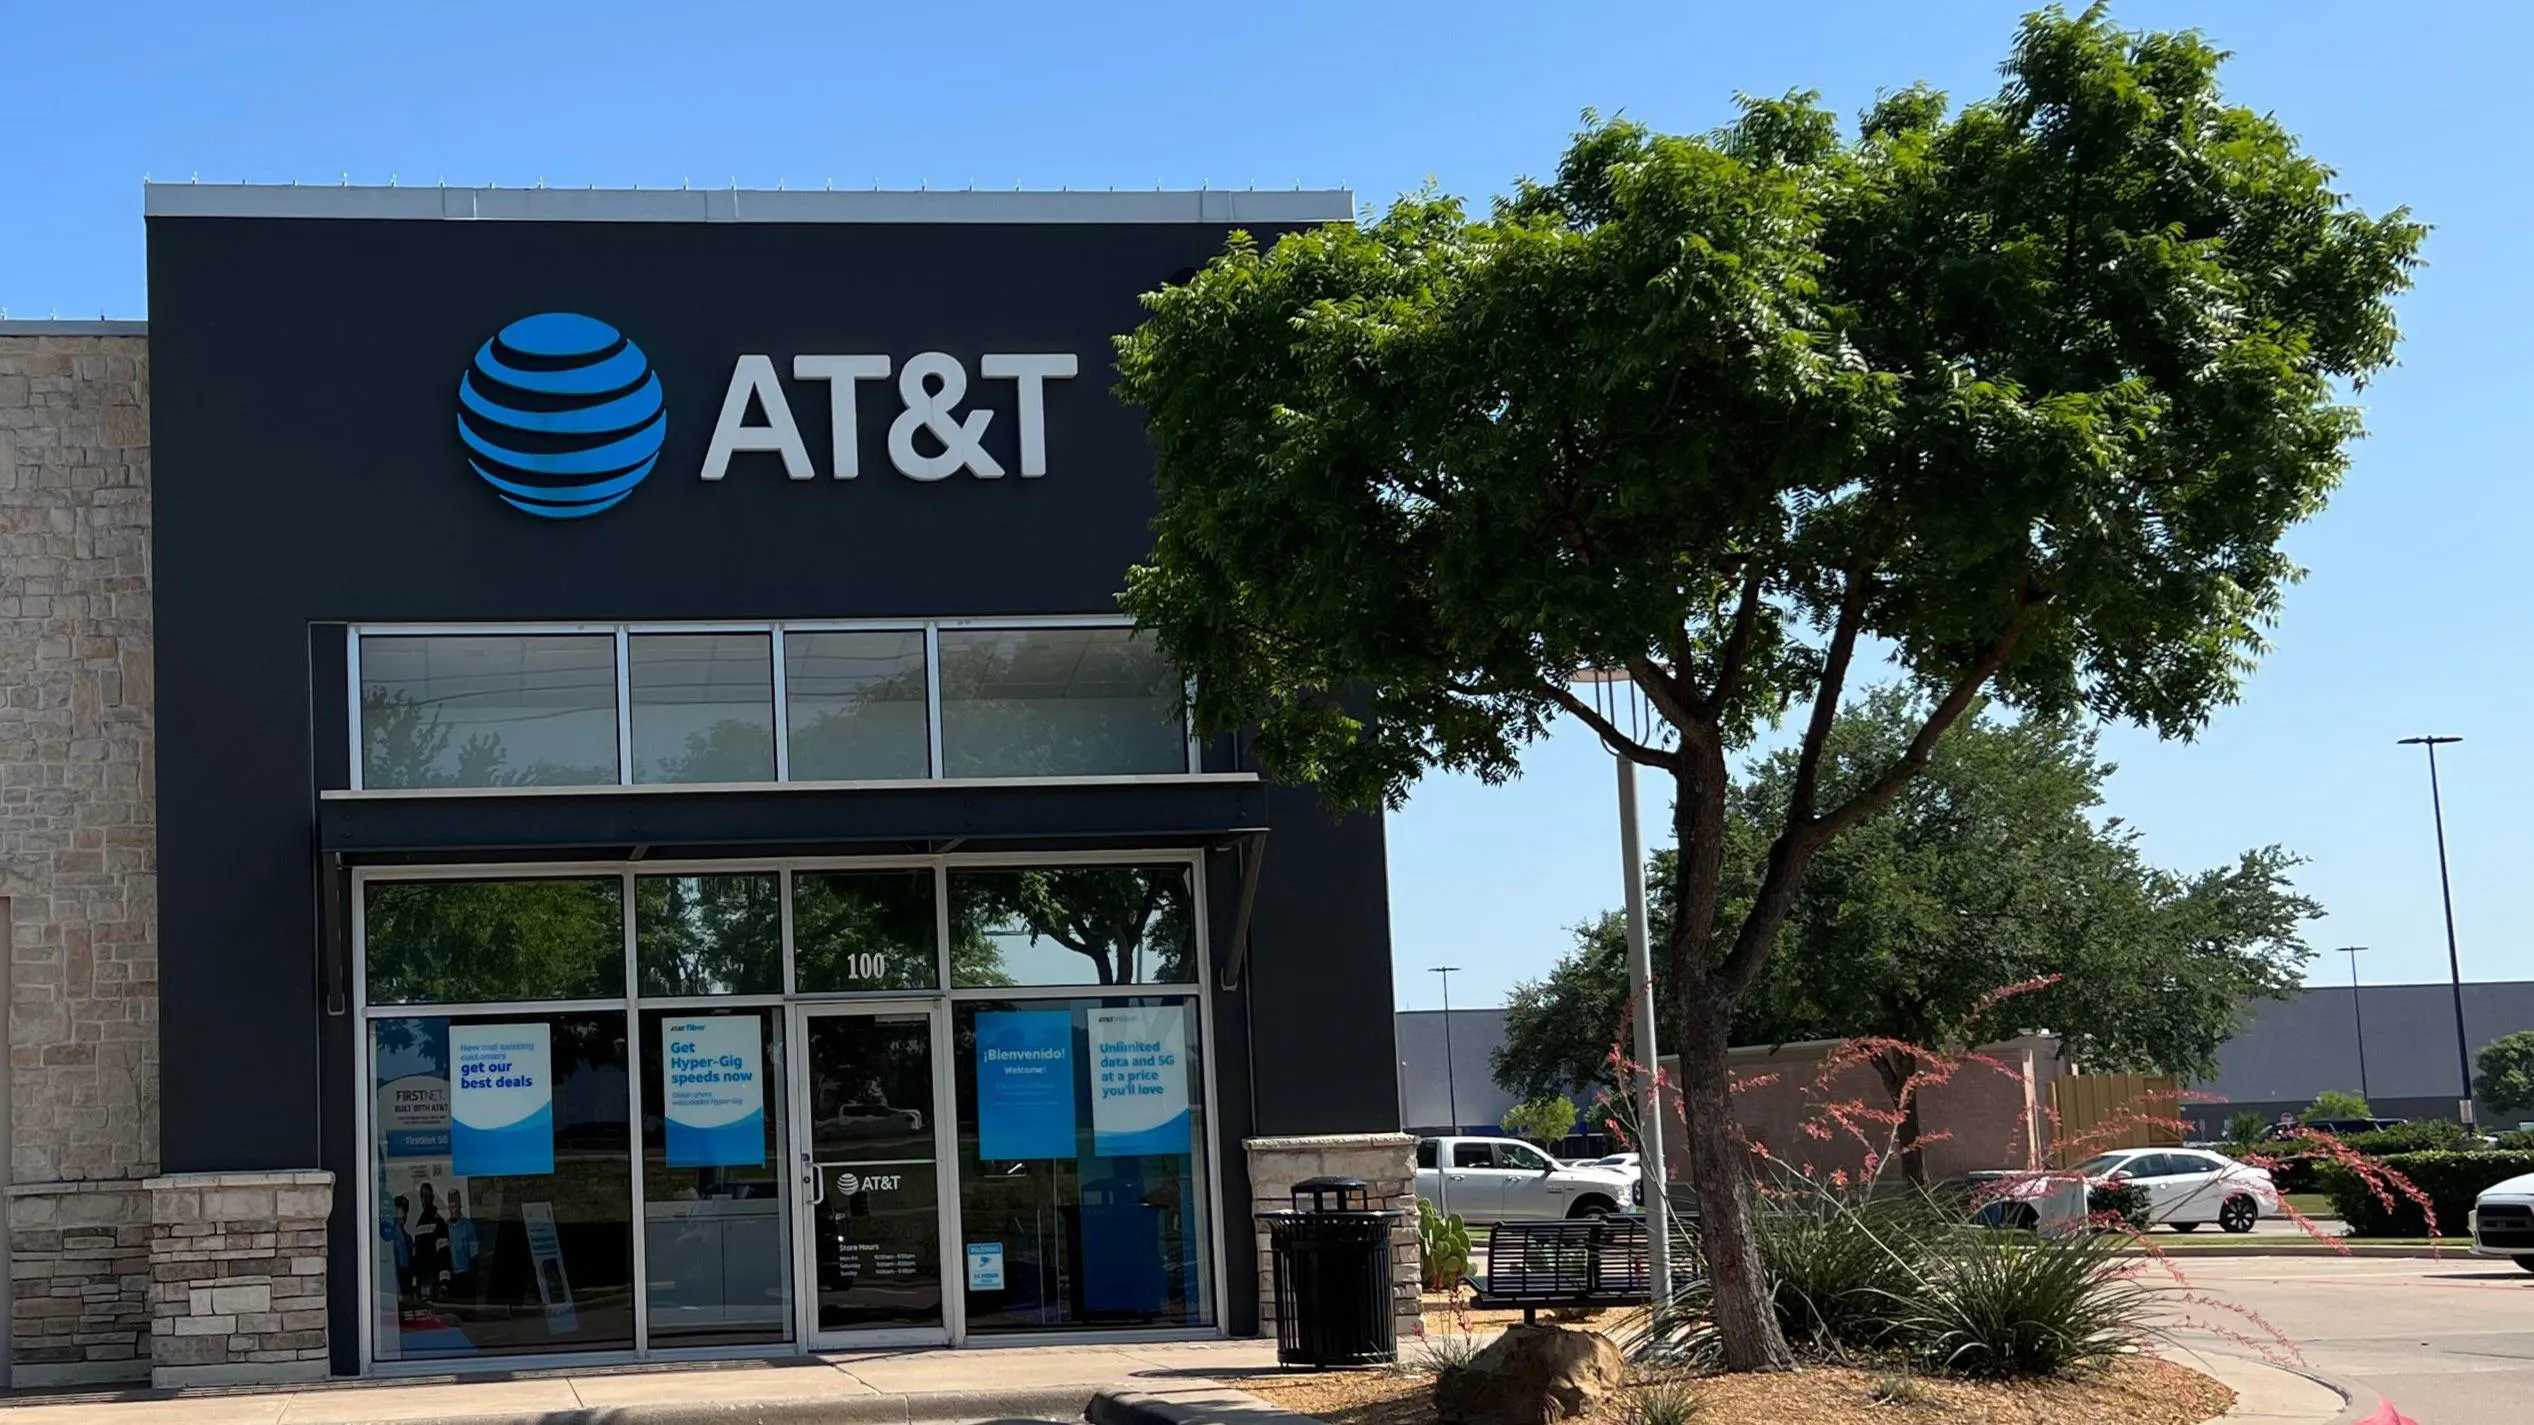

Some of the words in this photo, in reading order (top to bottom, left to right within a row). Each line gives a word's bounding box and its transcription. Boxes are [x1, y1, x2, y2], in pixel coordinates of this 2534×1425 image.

[700, 351, 1079, 482] AT&T
[847, 952, 885, 980] 100
[671, 1042, 696, 1054] Get
[1100, 1041, 1160, 1053] Unlimited
[671, 1055, 743, 1071] Hyper-Gig
[983, 1048, 1066, 1063] ¡Bienvenido!
[1100, 1056, 1129, 1068] data
[1131, 1055, 1155, 1067] and
[1158, 1055, 1175, 1066] 5G
[461, 1062, 485, 1076] get
[488, 1062, 512, 1073] our
[461, 1076, 492, 1089] best
[495, 1075, 533, 1088] deals
[671, 1070, 720, 1087] speeds
[723, 1071, 753, 1082] now
[1101, 1071, 1115, 1082] at
[1117, 1072, 1125, 1081] a
[1127, 1069, 1159, 1085] price
[1102, 1083, 1135, 1099] you'll
[1138, 1083, 1164, 1095] love
[861, 1175, 902, 1191] AT&T
[839, 1244, 858, 1252] Store
